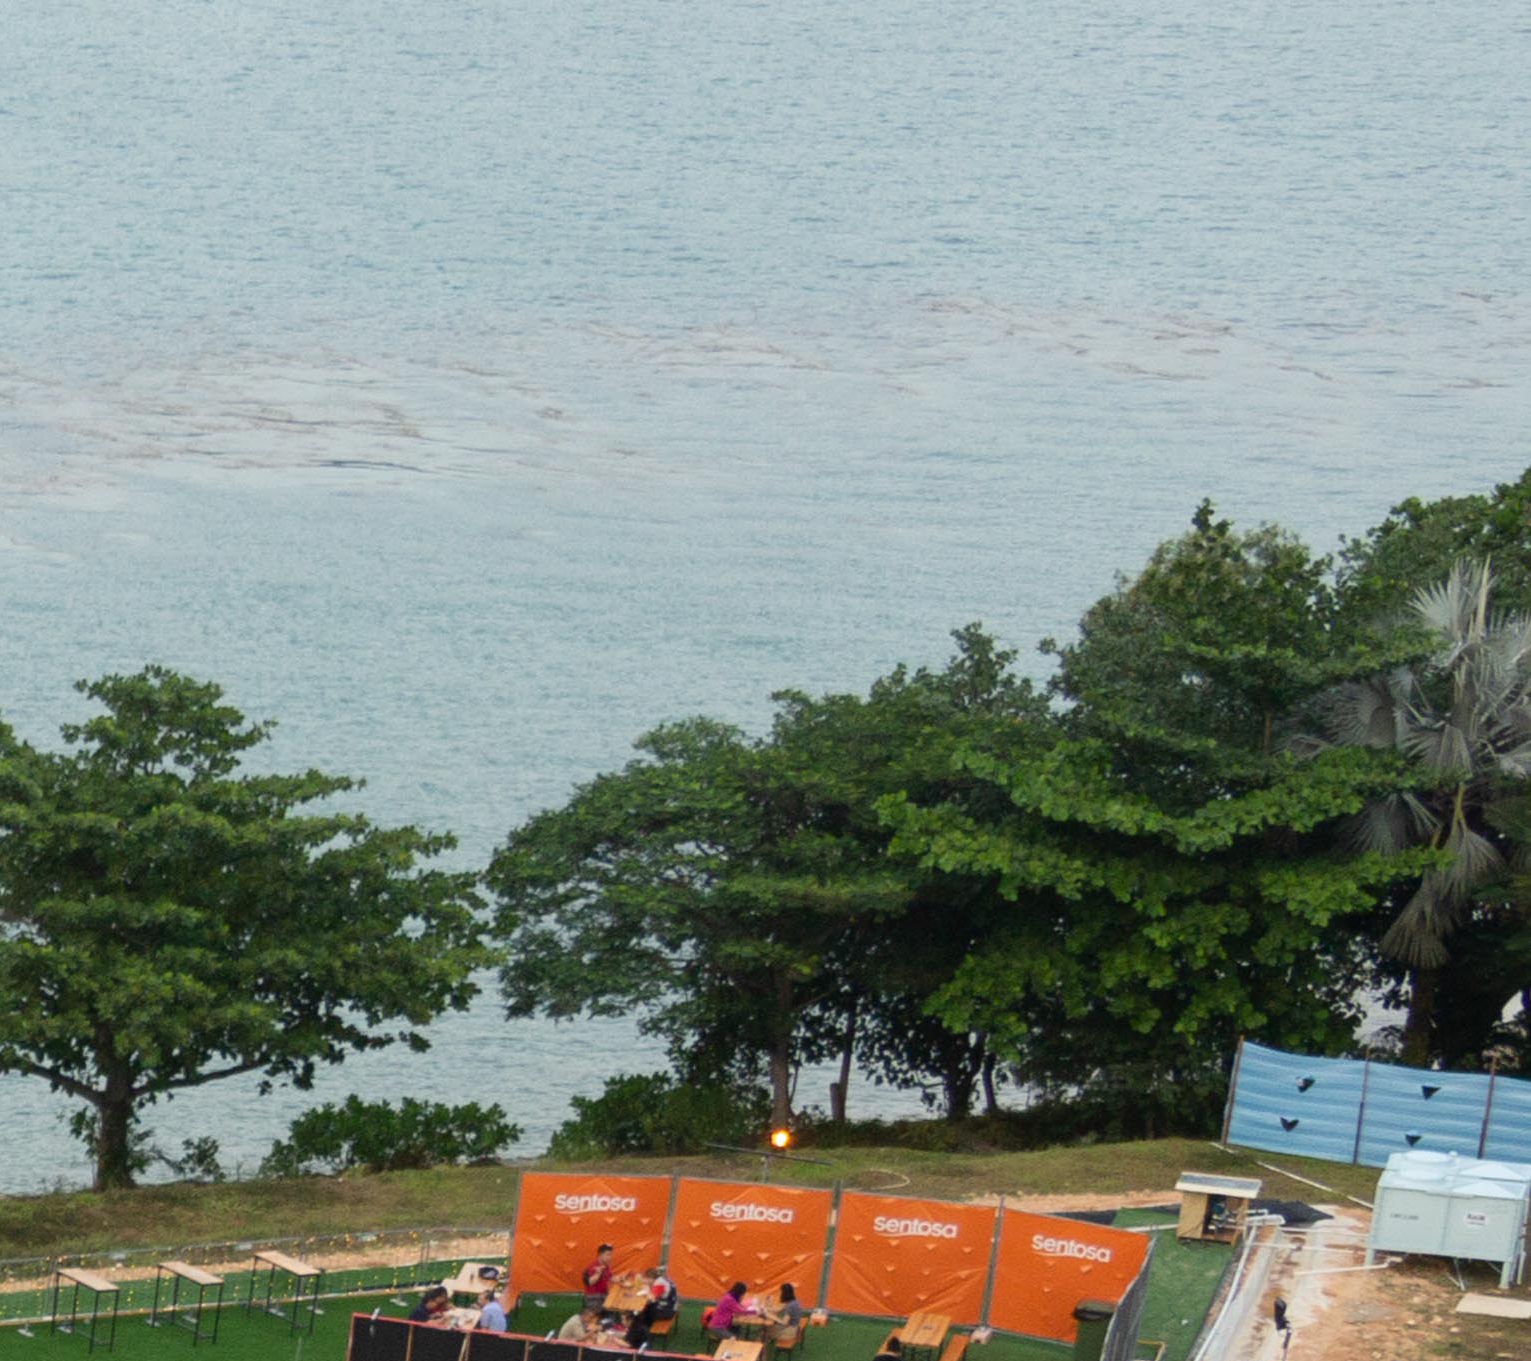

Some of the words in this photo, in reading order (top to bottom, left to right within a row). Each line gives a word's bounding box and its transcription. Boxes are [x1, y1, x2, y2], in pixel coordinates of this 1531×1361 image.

[554, 1193, 636, 1214] sentosa
[710, 1202, 794, 1224] sentosa
[873, 1216, 959, 1239] sentosa
[1031, 1234, 1112, 1264] sentosa
